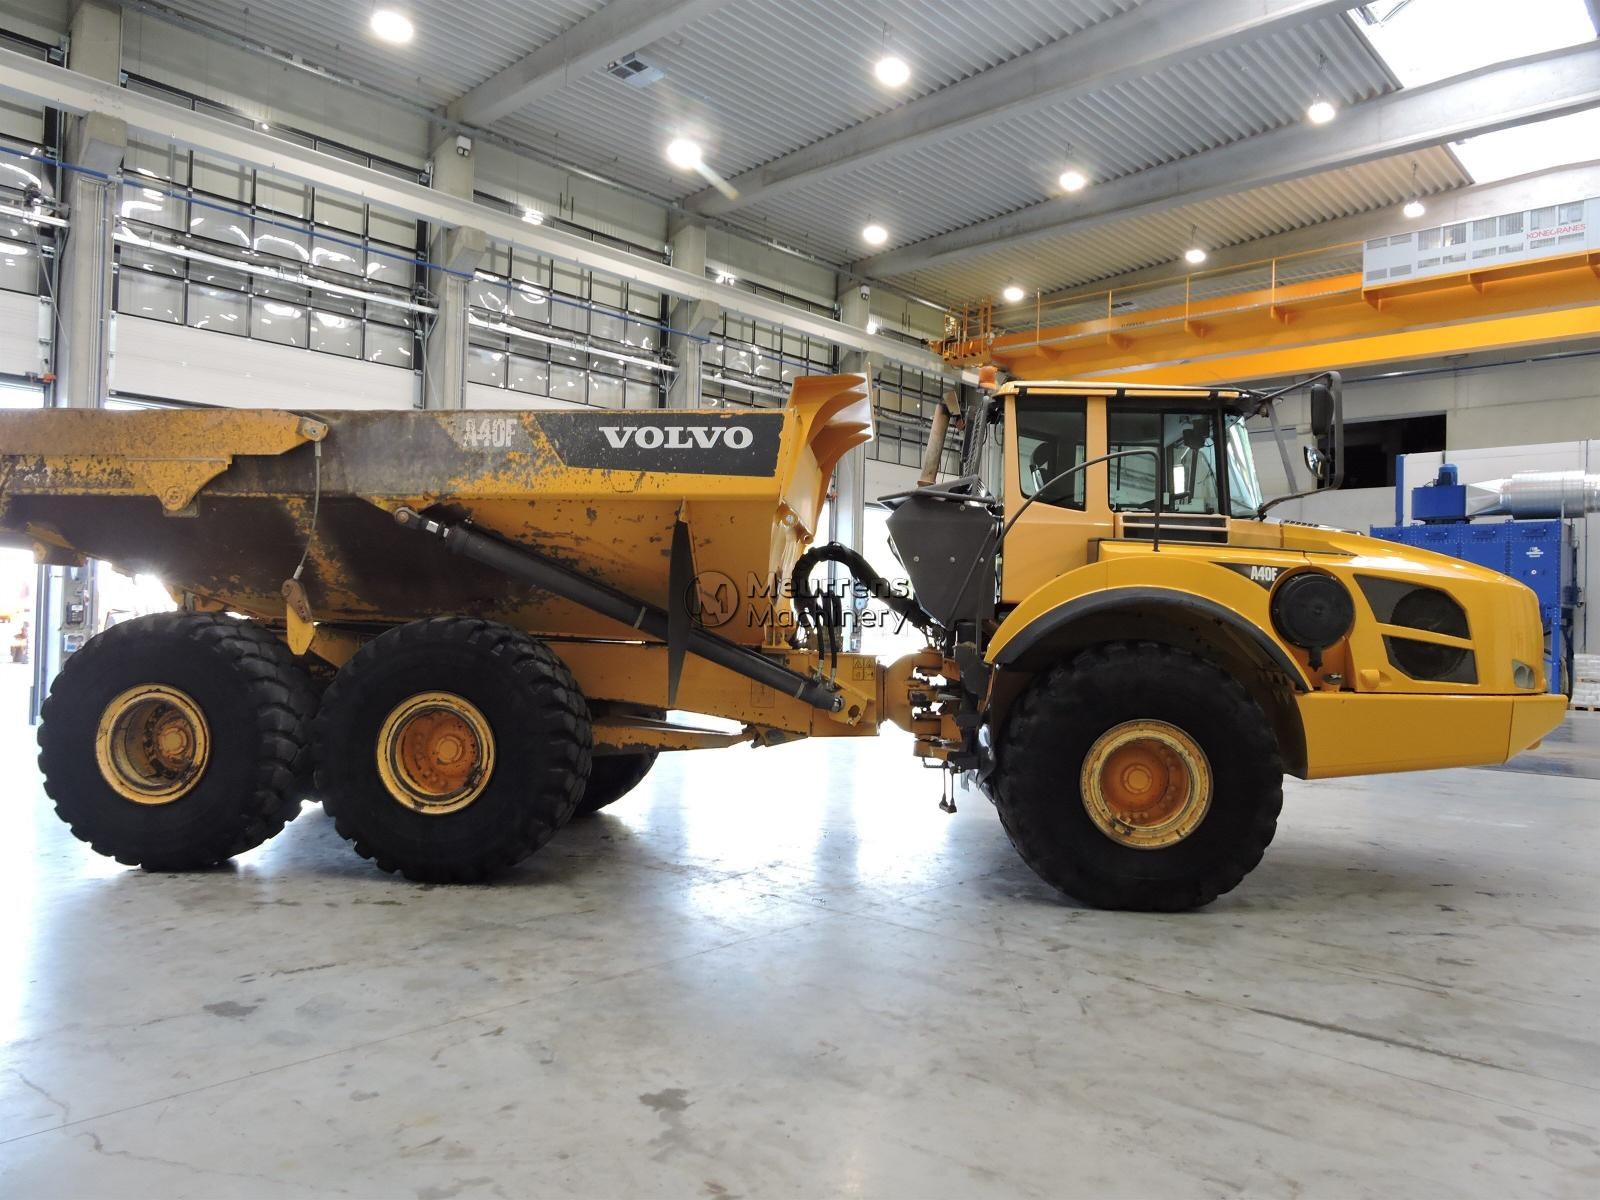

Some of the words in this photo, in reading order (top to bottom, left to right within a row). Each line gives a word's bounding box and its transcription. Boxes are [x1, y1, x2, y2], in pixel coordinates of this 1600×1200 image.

[1526, 223, 1586, 239] KONECRANES
[463, 418, 517, 448] A40F
[598, 426, 754, 449] VOLVO
[1250, 565, 1278, 582] A40F
